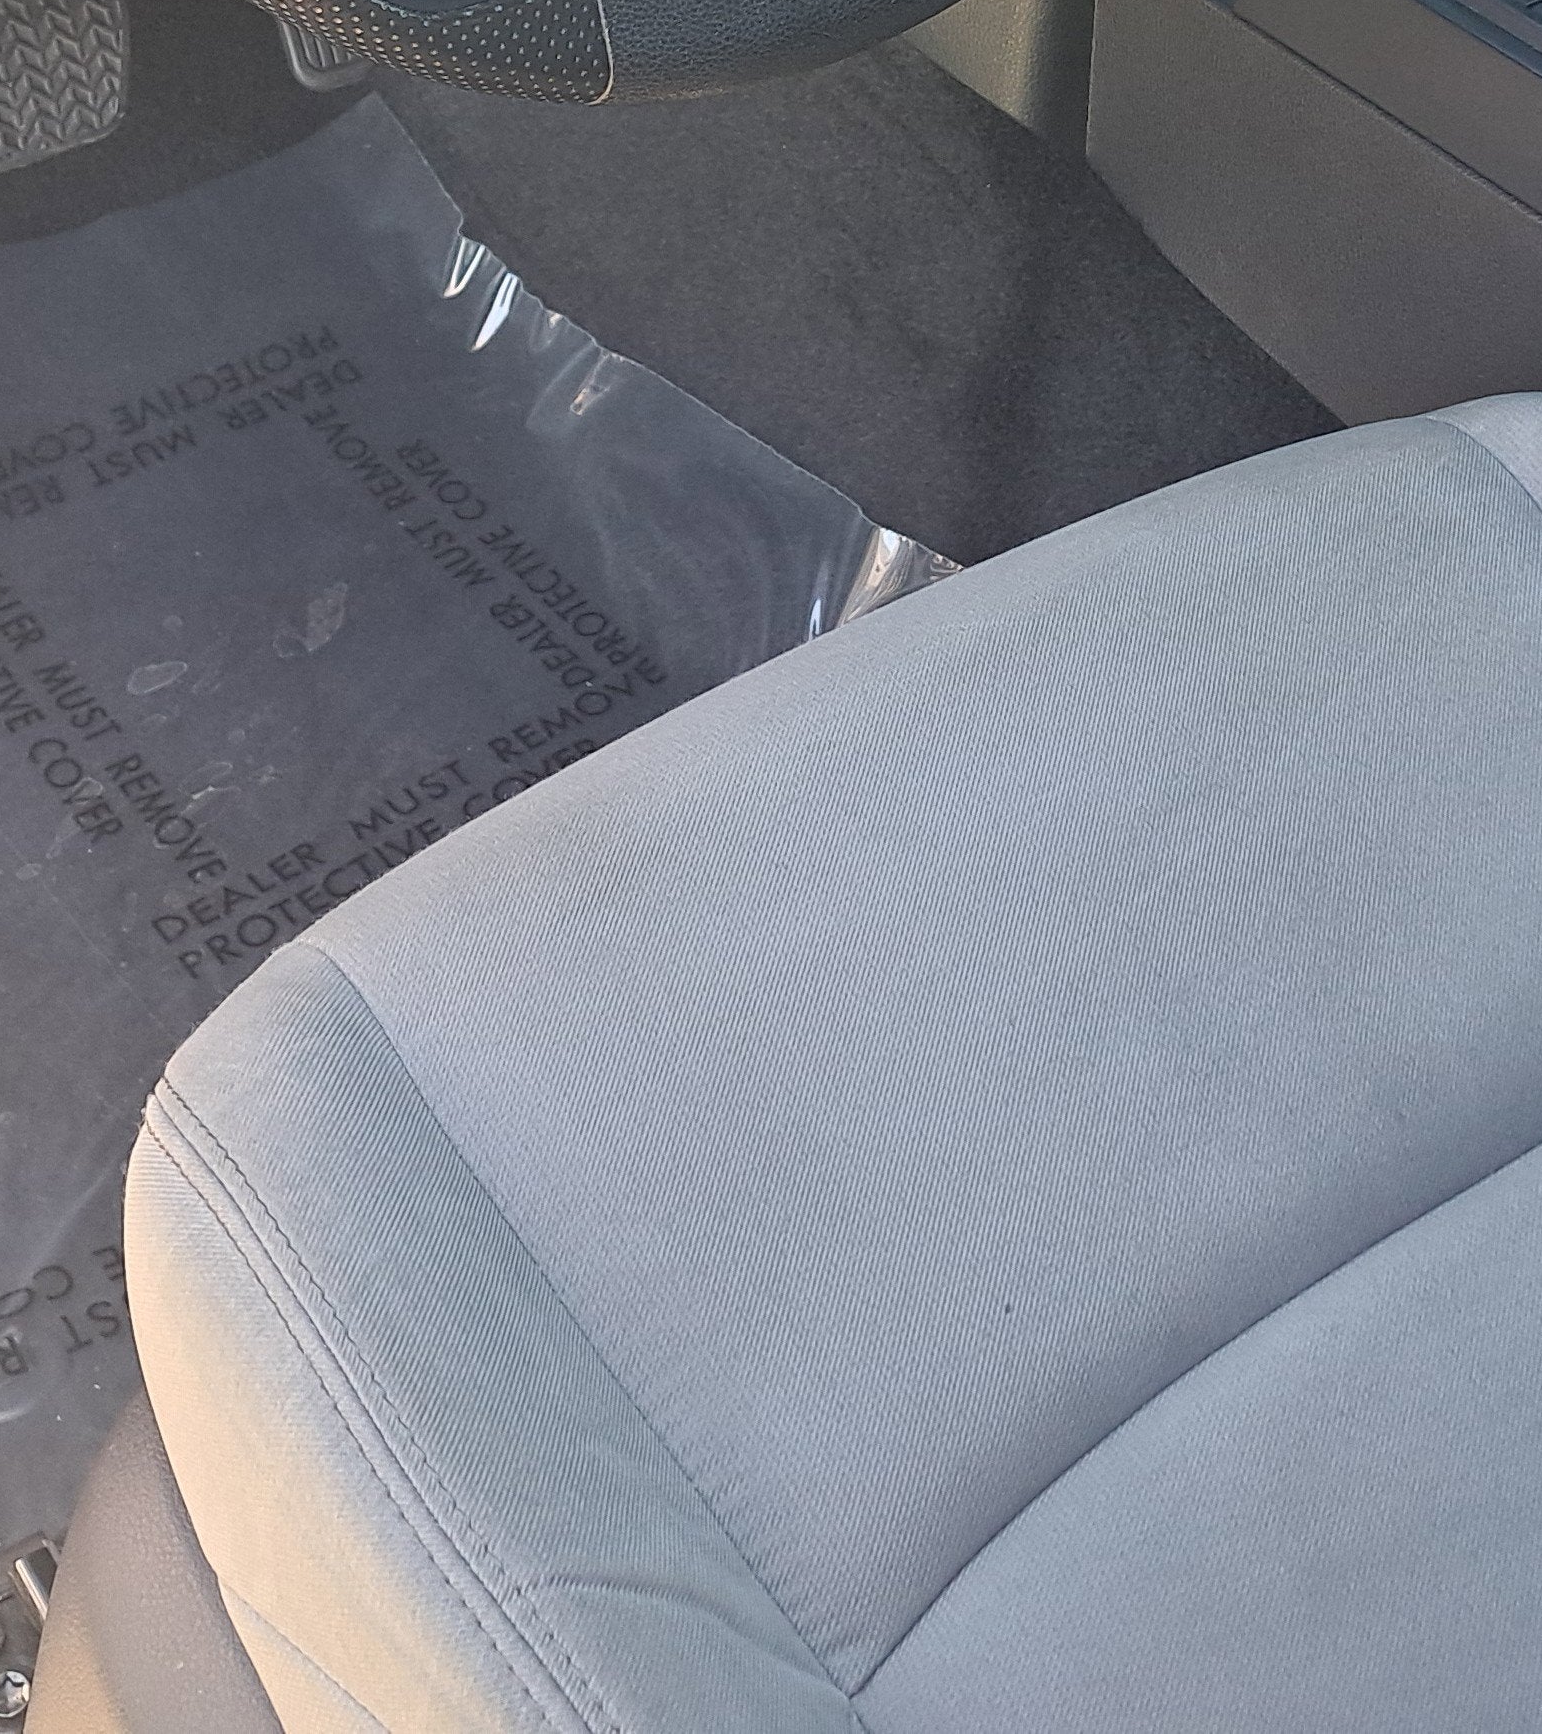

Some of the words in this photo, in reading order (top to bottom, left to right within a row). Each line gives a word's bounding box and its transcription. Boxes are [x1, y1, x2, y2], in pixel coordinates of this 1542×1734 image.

[111, 324, 340, 435] PROTECTIVE
[218, 356, 363, 431] DEALER
[87, 424, 198, 488] MUST
[303, 403, 412, 512] REMOVE
[396, 439, 486, 523] COVER
[401, 519, 495, 589] MUST
[481, 524, 647, 669] PROTECTIVE
[489, 592, 596, 690] DEALER
[28, 737, 125, 845] COVER
[38, 662, 122, 741] MUST
[104, 753, 227, 882] REMOVE
[152, 842, 328, 945] DEALER
[348, 760, 470, 842] MUST
[487, 666, 667, 764] REMOVE
[177, 818, 459, 979] PROTECTIVE
